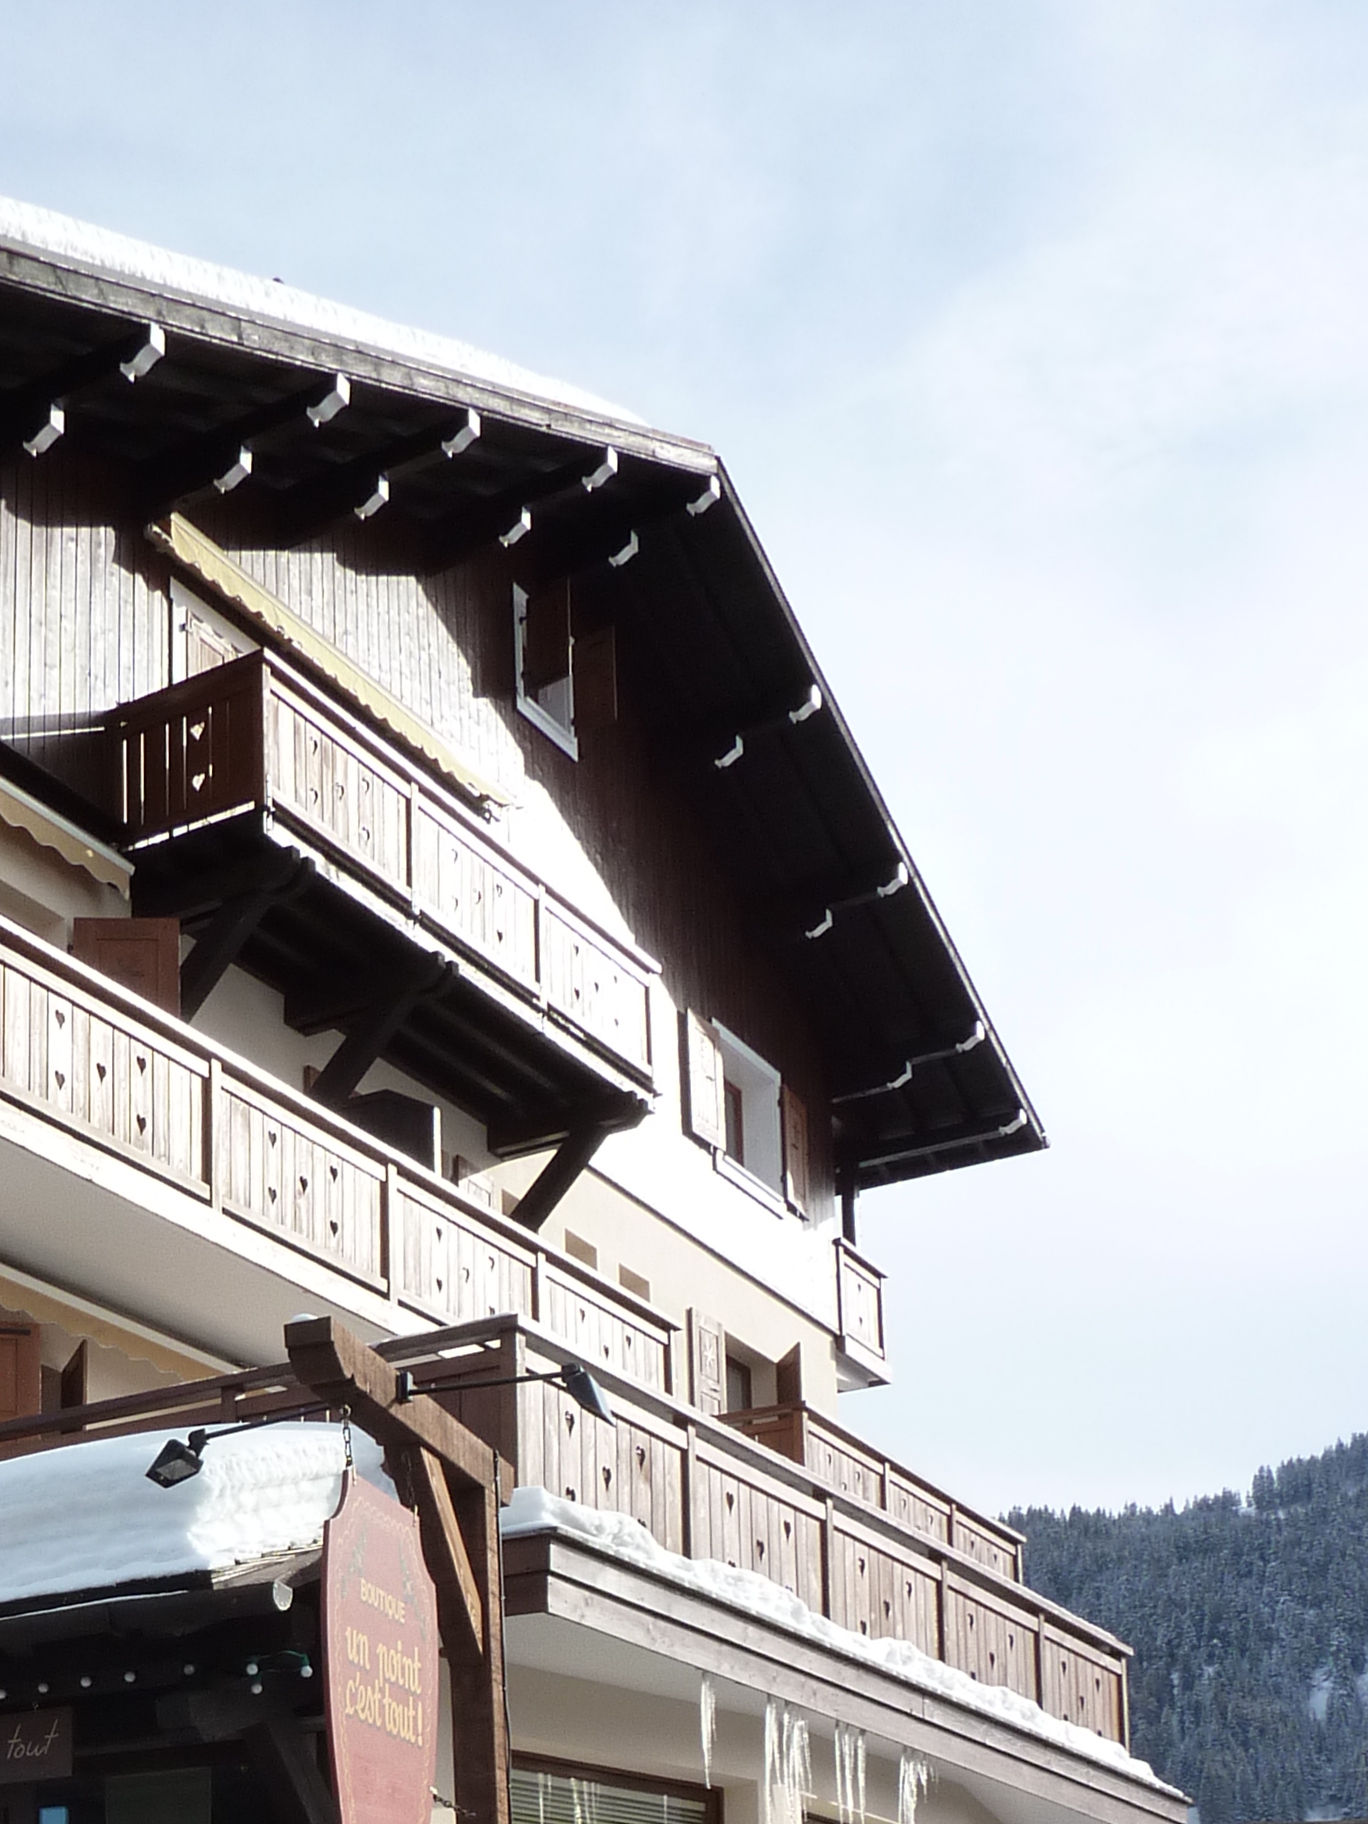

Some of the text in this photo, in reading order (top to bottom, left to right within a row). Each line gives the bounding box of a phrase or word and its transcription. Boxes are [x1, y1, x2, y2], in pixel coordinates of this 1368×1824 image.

[360, 1577, 405, 1623] BOUTIQUE
[345, 1626, 422, 1695] un point
[345, 1671, 383, 1727] c'est
[6, 1718, 60, 1760] tout
